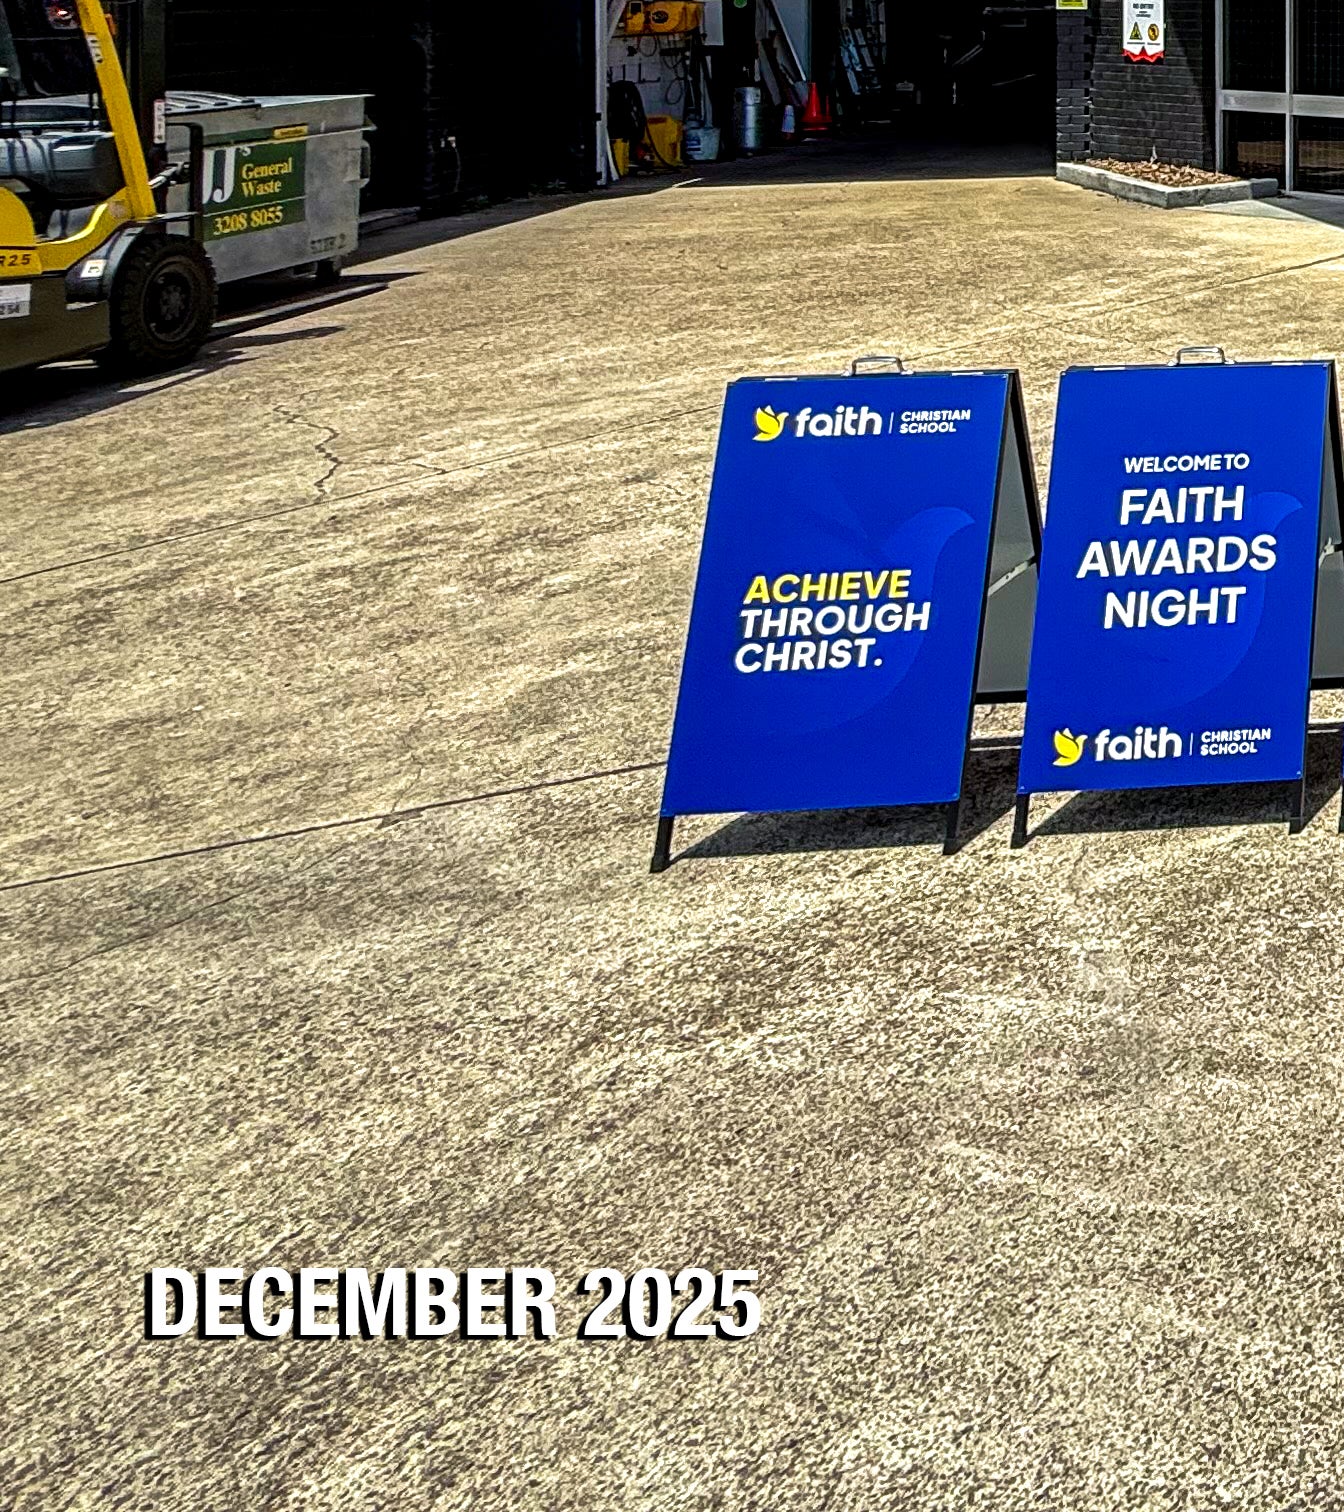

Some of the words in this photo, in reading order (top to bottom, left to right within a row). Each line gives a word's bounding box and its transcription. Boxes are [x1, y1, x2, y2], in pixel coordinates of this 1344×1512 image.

[242, 158, 292, 178] General
[241, 180, 282, 197] Waste
[213, 214, 247, 235] 3208
[795, 406, 882, 437] faith
[900, 422, 956, 433] SCHOOL
[901, 410, 970, 422] CHRISTIAN
[1125, 454, 1222, 473] WELCOME
[1224, 453, 1249, 469] TO
[1120, 486, 1244, 525] FAITH
[1076, 534, 1276, 578] AWARDS
[743, 570, 911, 604] ACHIEVE
[740, 602, 930, 638] THROUGH
[1104, 587, 1246, 629] NIGHT
[735, 638, 882, 673] CHRIST.
[1095, 726, 1182, 761] faith
[1201, 728, 1271, 743] CHRISTIAN
[1201, 742, 1257, 755] SCHOOL
